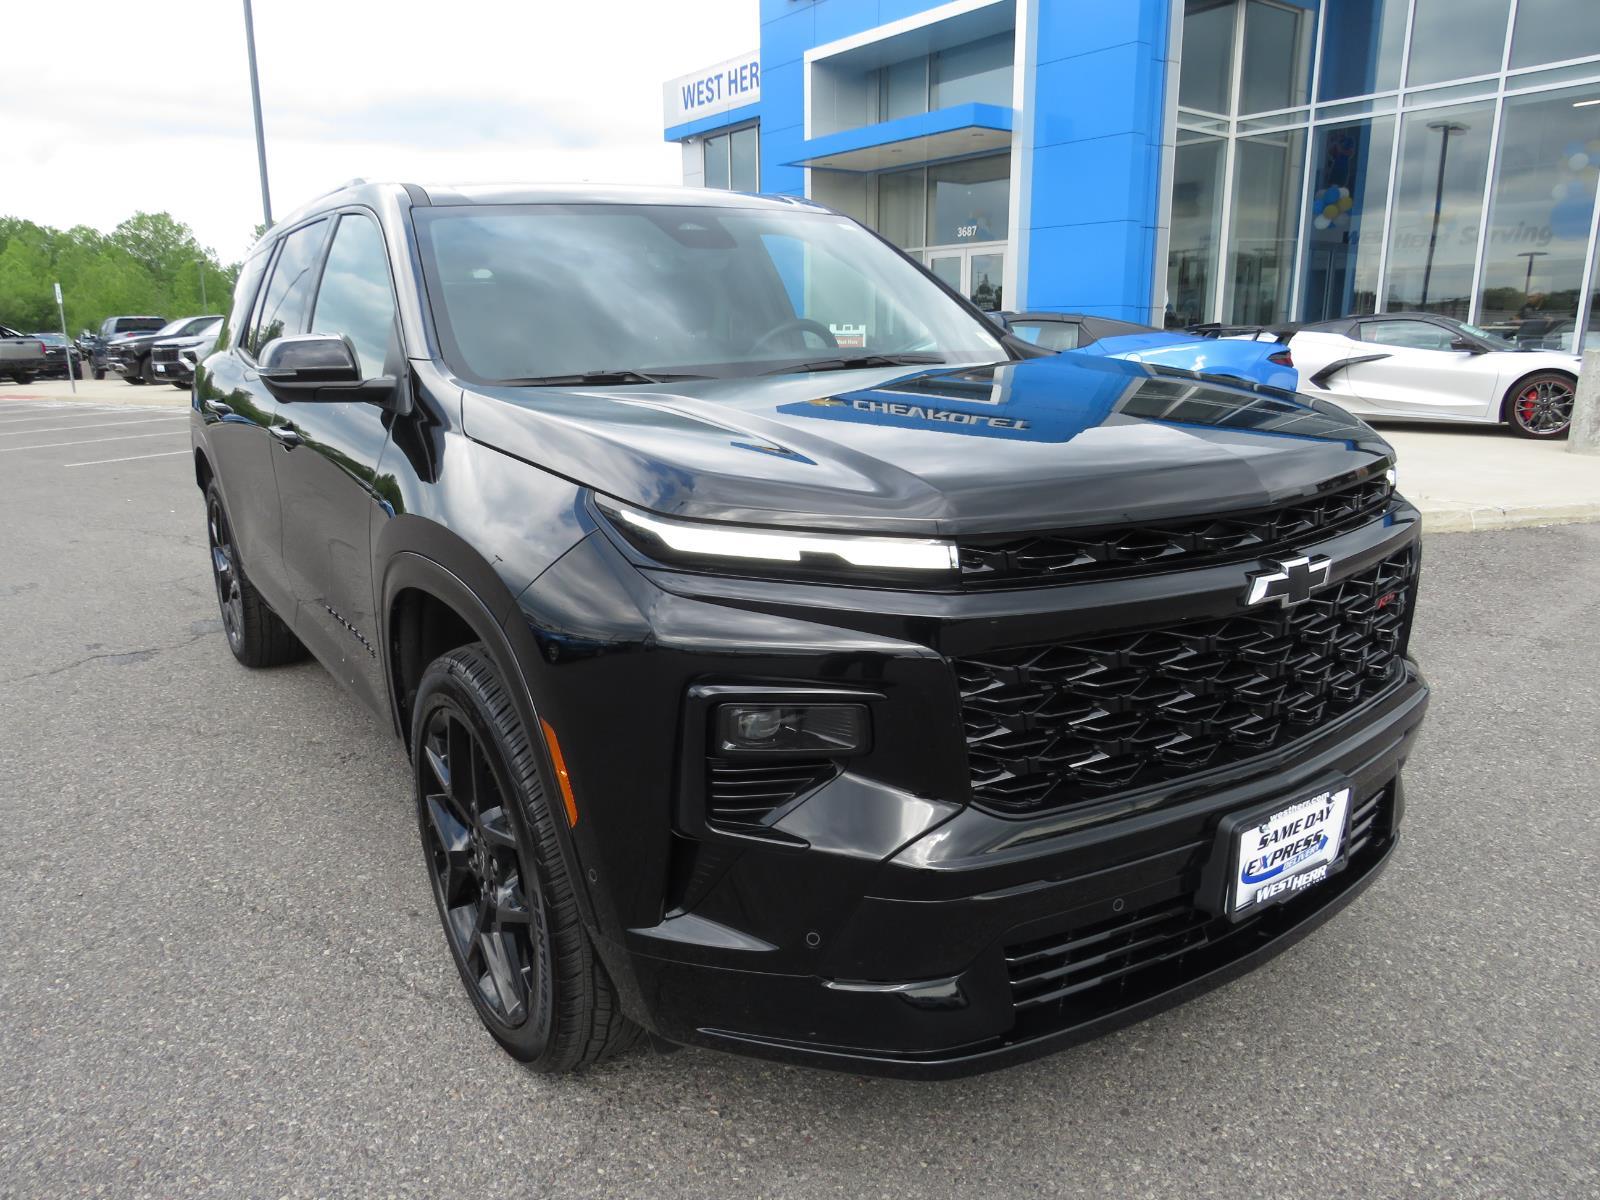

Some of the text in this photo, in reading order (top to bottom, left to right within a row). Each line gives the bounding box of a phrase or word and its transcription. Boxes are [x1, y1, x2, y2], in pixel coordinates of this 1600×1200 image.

[682, 73, 723, 110] WEST
[957, 226, 977, 238] 3687
[1459, 221, 1552, 247] Srving
[1257, 803, 1335, 851] SAME DAY
[1246, 829, 1324, 875] EXPRESS
